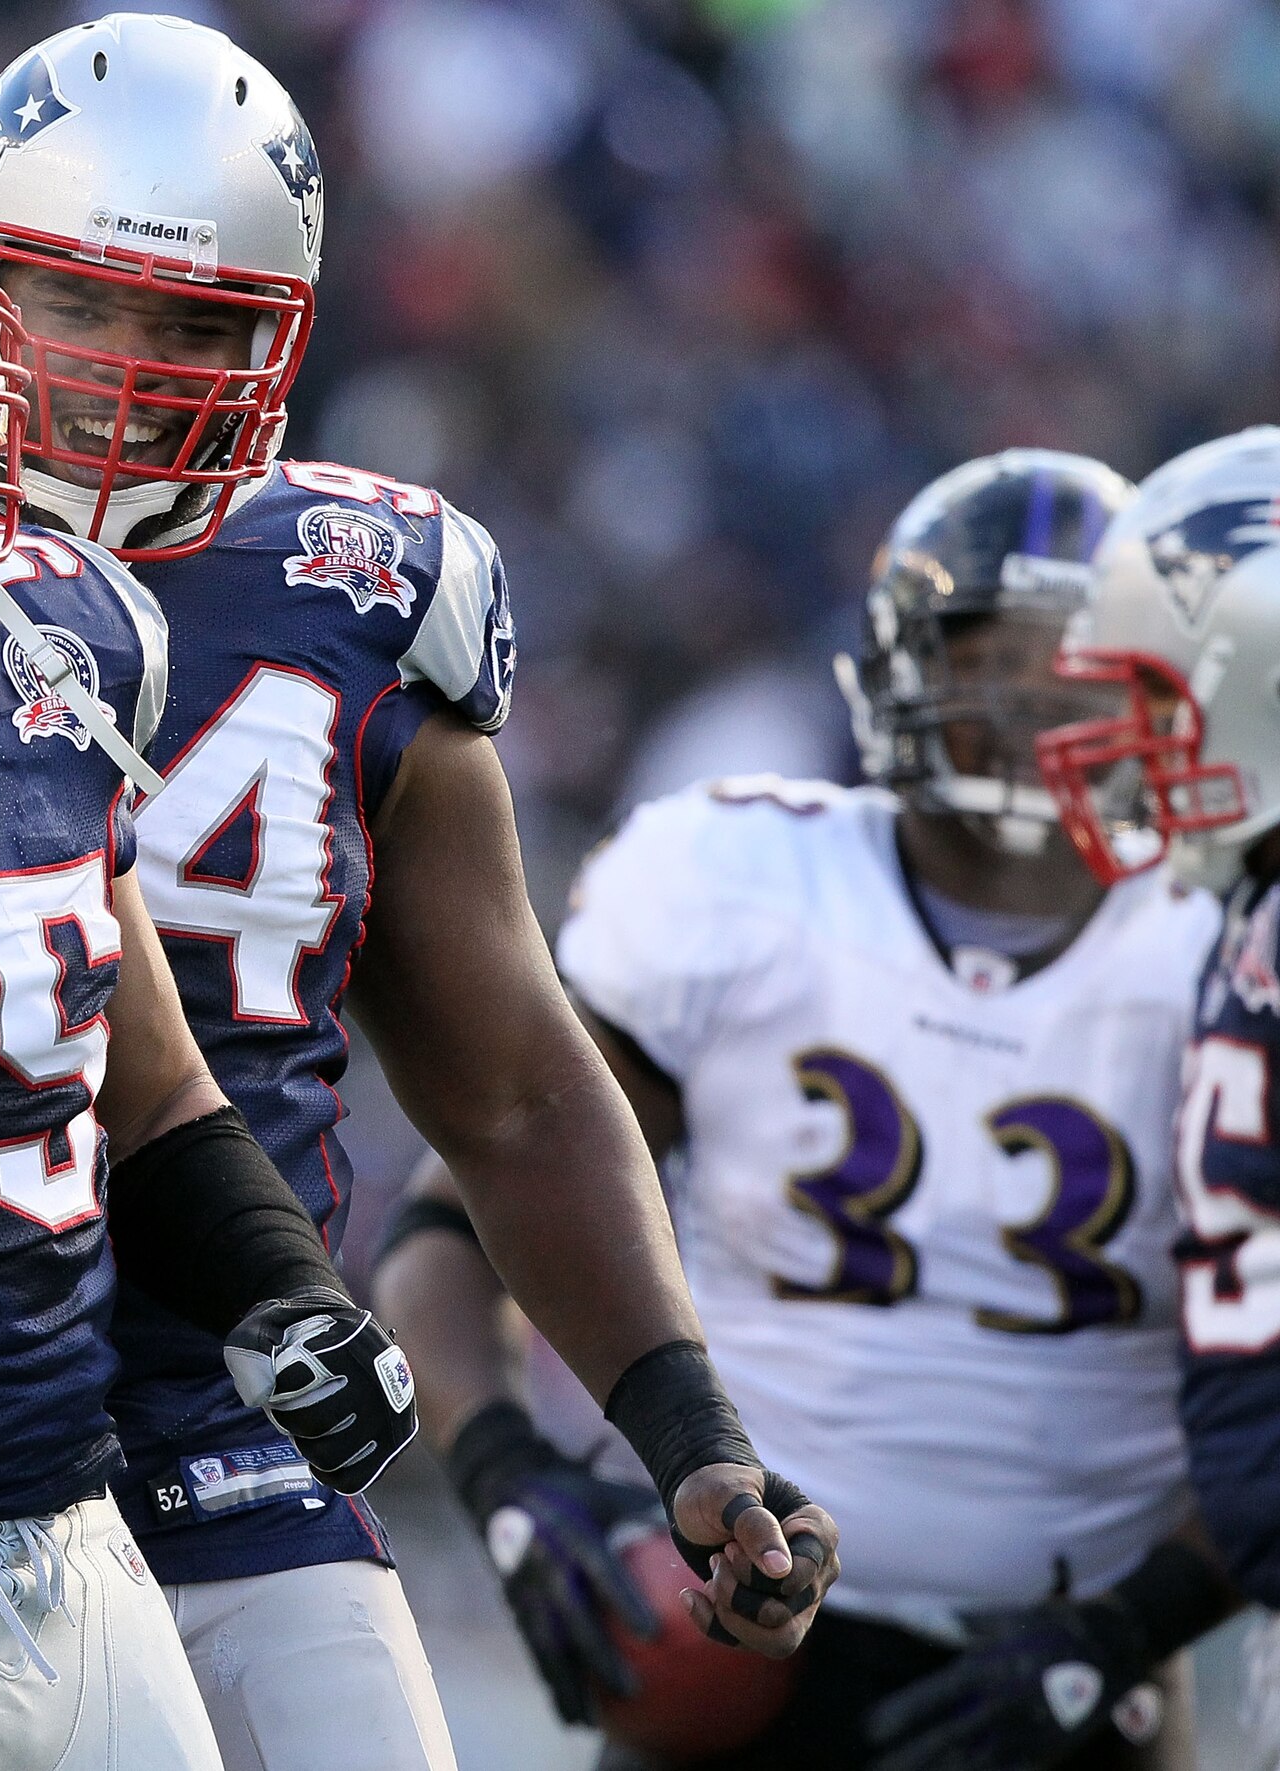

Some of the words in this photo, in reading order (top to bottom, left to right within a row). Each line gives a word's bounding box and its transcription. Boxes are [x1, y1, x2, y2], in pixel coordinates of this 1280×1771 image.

[116, 216, 189, 242] Riddell
[324, 556, 381, 576] SEASONS
[768, 1042, 1143, 1335] 33
[381, 1361, 405, 1405] EQUIPMENT
[156, 1484, 188, 1512] 52
[283, 1480, 310, 1490] Reebok
